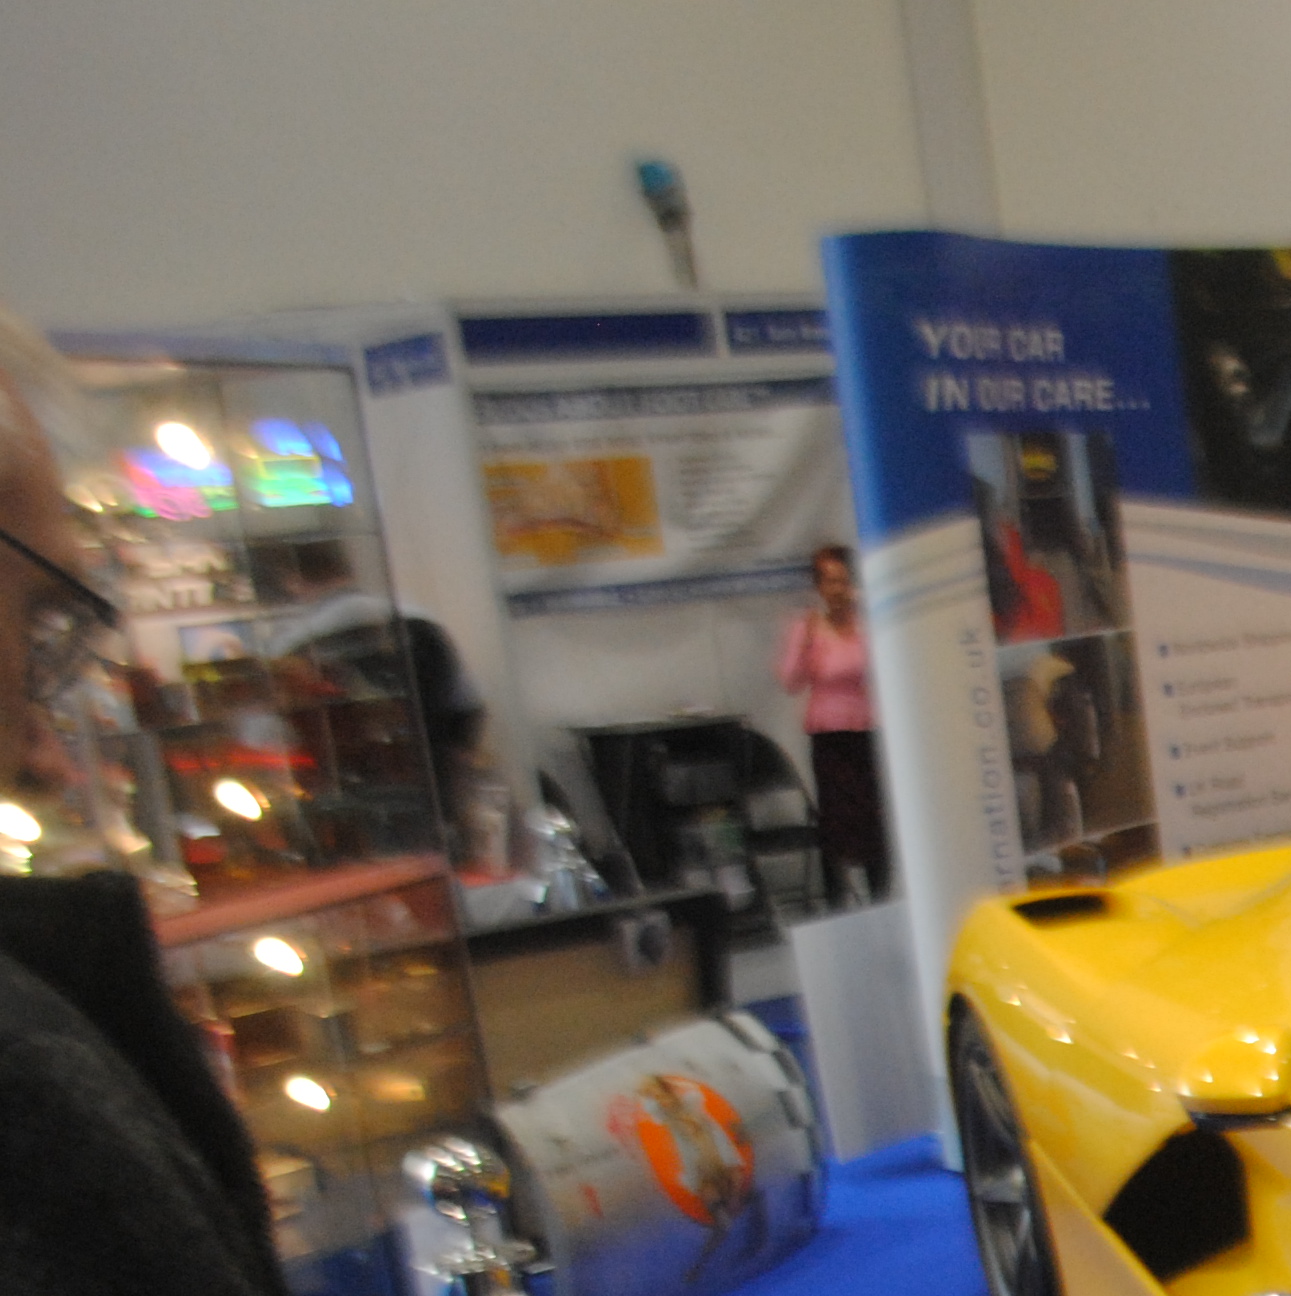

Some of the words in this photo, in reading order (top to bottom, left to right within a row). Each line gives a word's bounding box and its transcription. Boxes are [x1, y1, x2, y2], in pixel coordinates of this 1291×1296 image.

[1007, 321, 1065, 363] CAR
[922, 372, 969, 413] IN
[975, 374, 1027, 412] OUR
